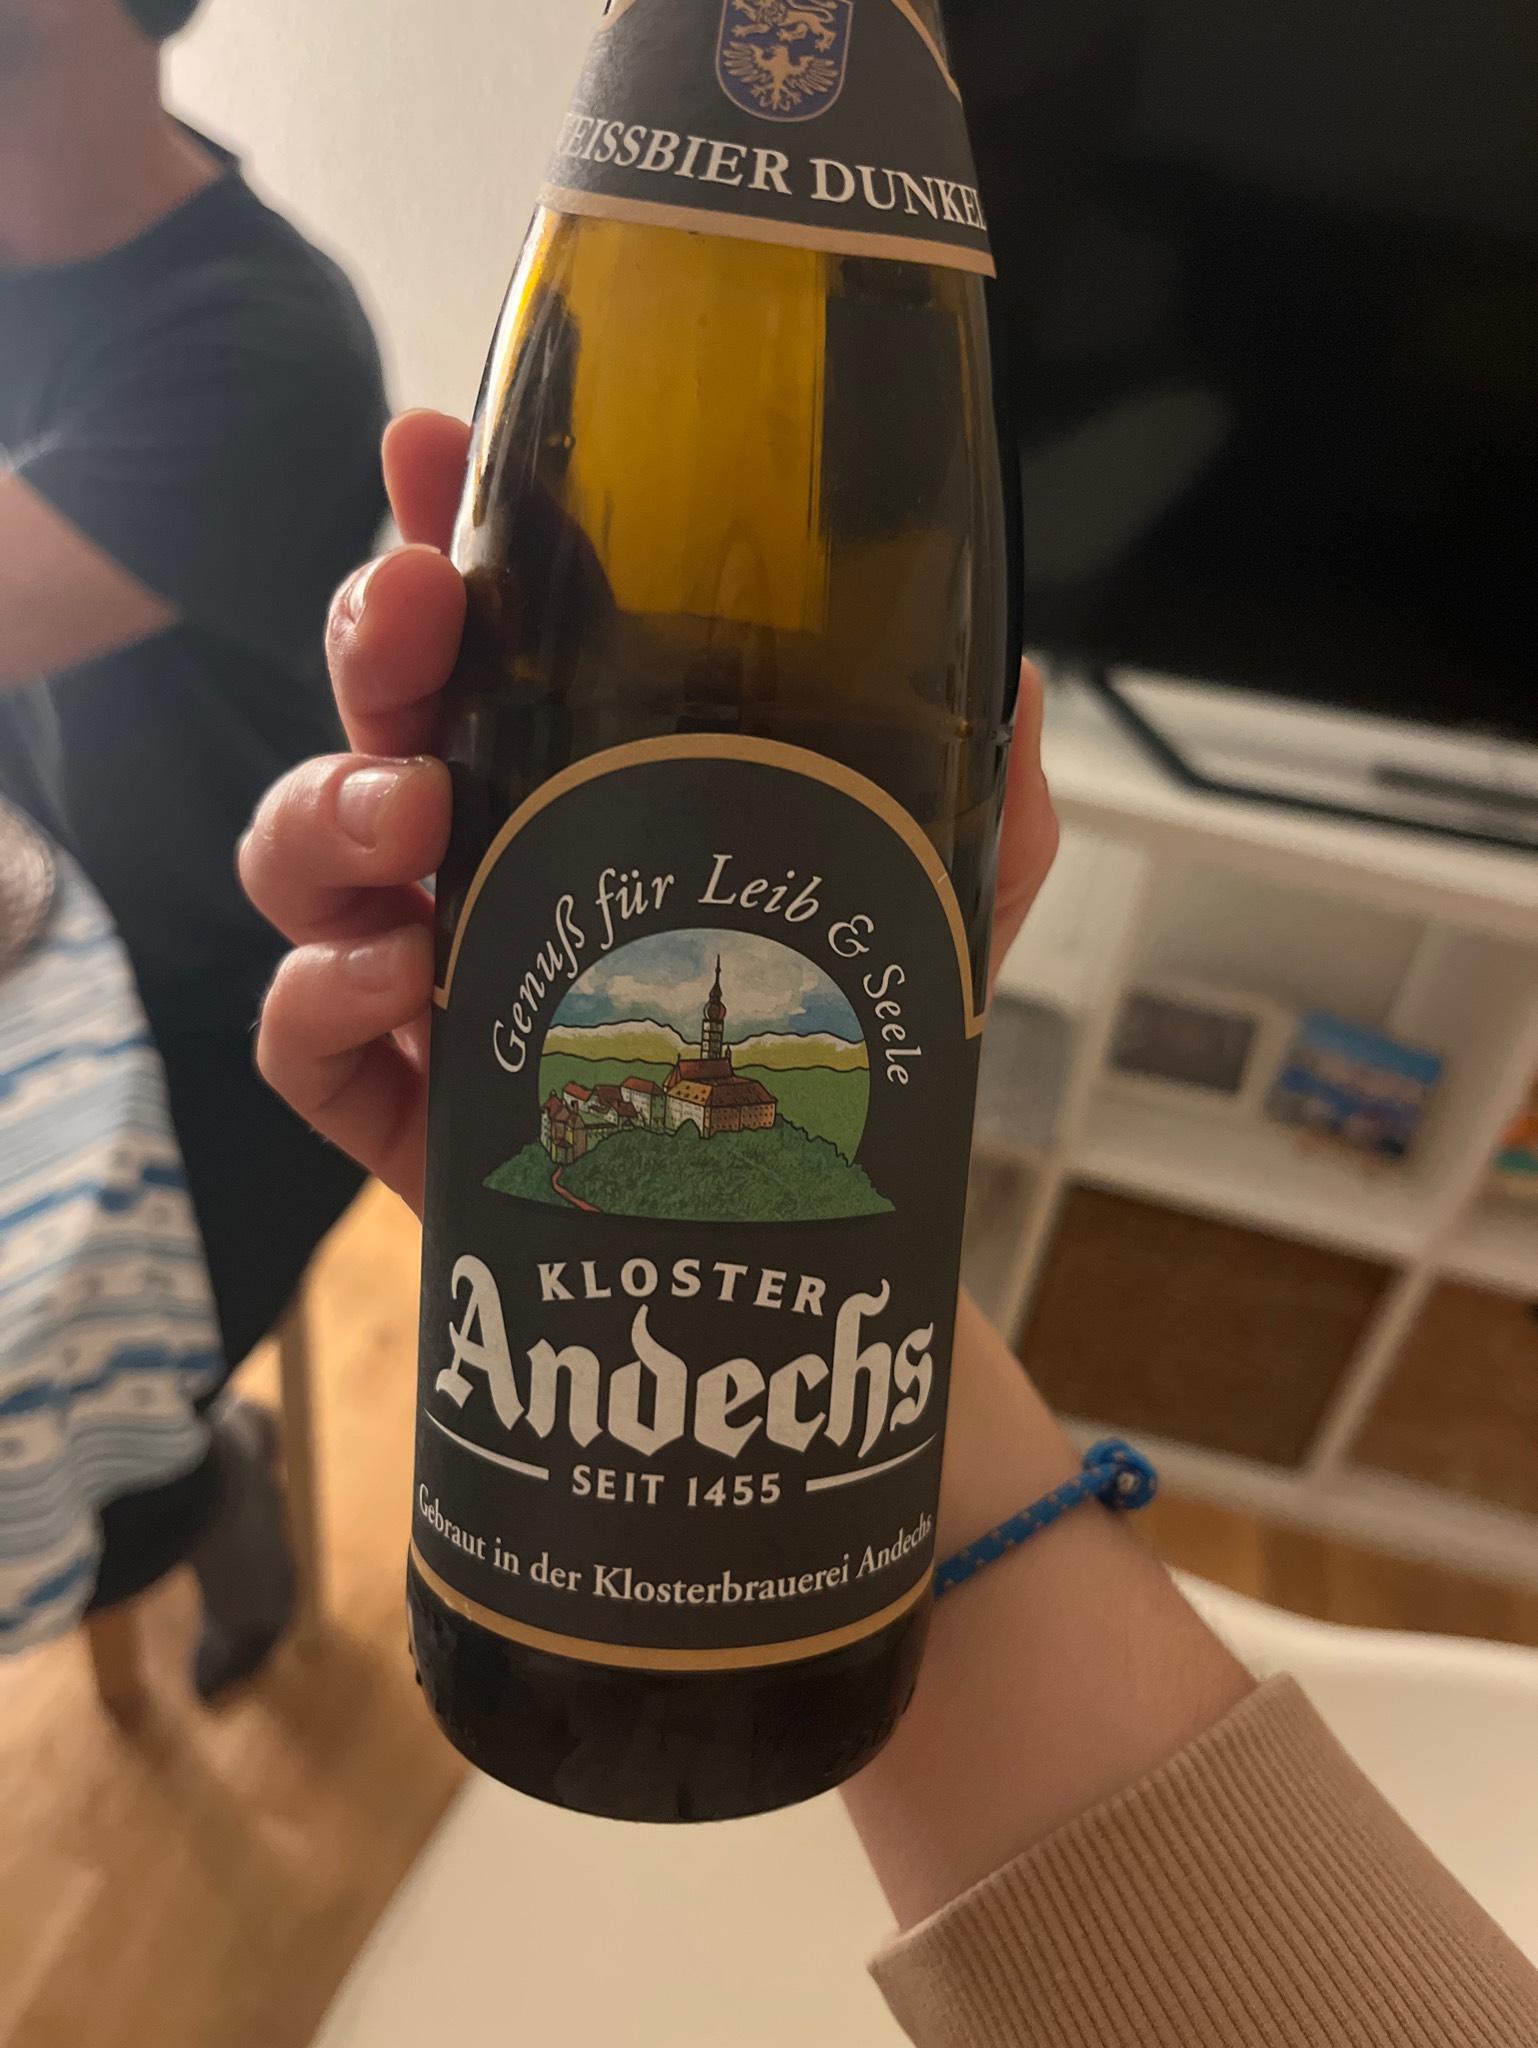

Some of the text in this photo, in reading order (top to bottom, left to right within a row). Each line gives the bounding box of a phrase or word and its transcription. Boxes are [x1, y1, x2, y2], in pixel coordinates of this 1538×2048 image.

[492, 853, 922, 1085] Genuß für Leib & Seele
[537, 1257, 827, 1316] KLOSTER
[434, 1253, 935, 1458] Andechs
[419, 1483, 932, 1605] Gebraut in der Klosterbrauerei Andechs
[572, 1464, 781, 1507] SEIT 1455
